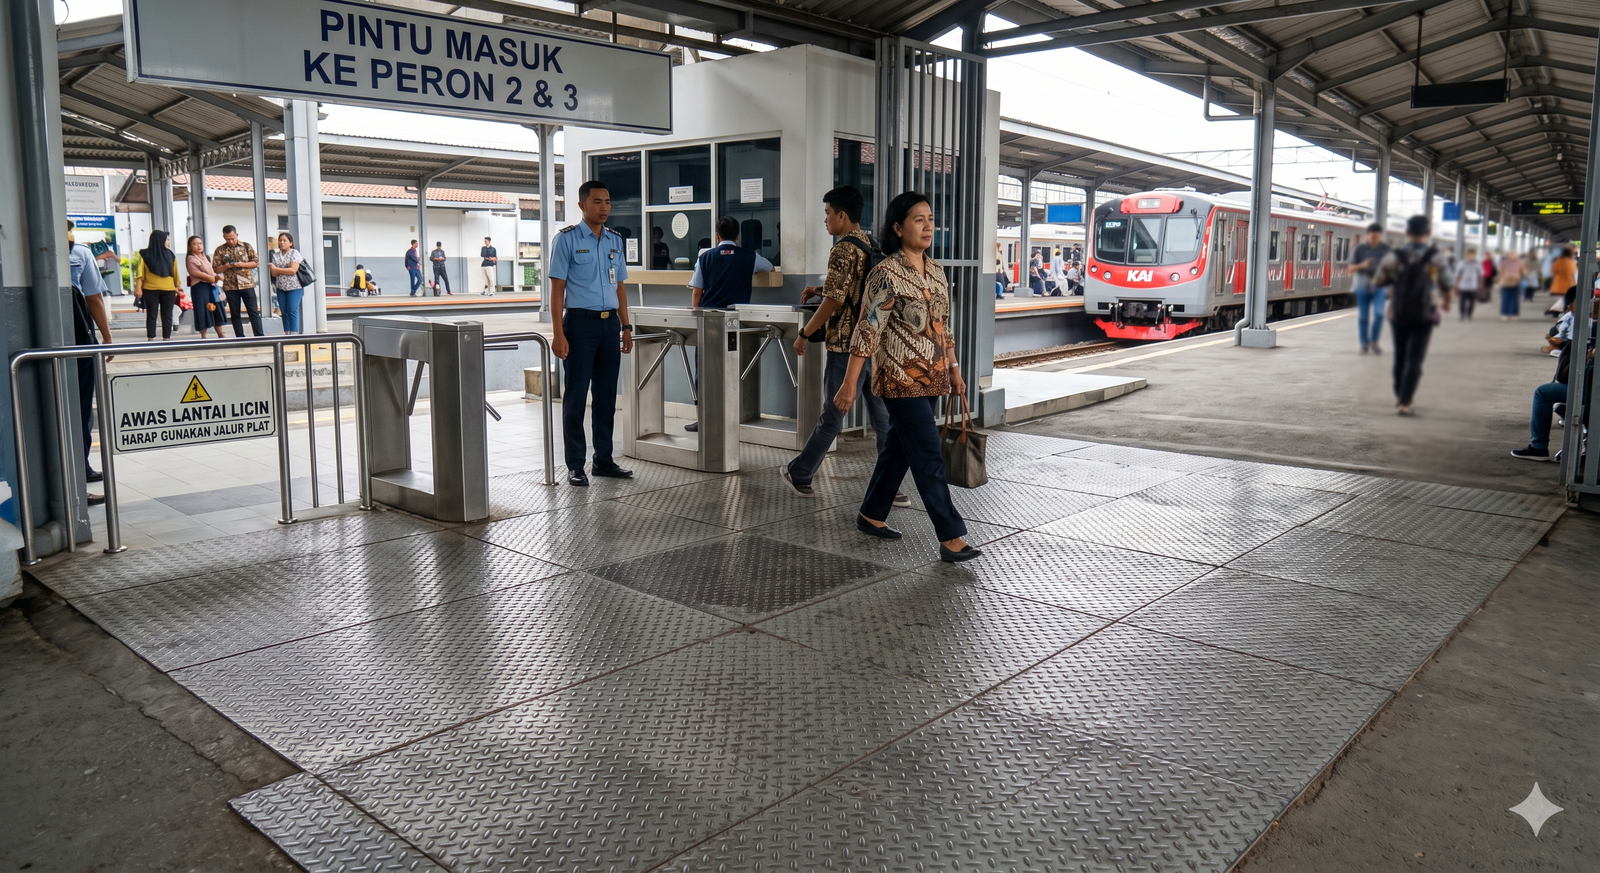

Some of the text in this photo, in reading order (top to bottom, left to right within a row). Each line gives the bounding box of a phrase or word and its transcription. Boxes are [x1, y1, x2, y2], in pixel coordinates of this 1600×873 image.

[320, 9, 564, 74] PINTU MASUK
[303, 49, 579, 111] KE PERON 2 & 3
[1126, 269, 1154, 282] KAI
[120, 401, 270, 428] AWAS LANTAI LICIN
[121, 421, 270, 446] HARAP GUNAKAN JALUR PLAT
